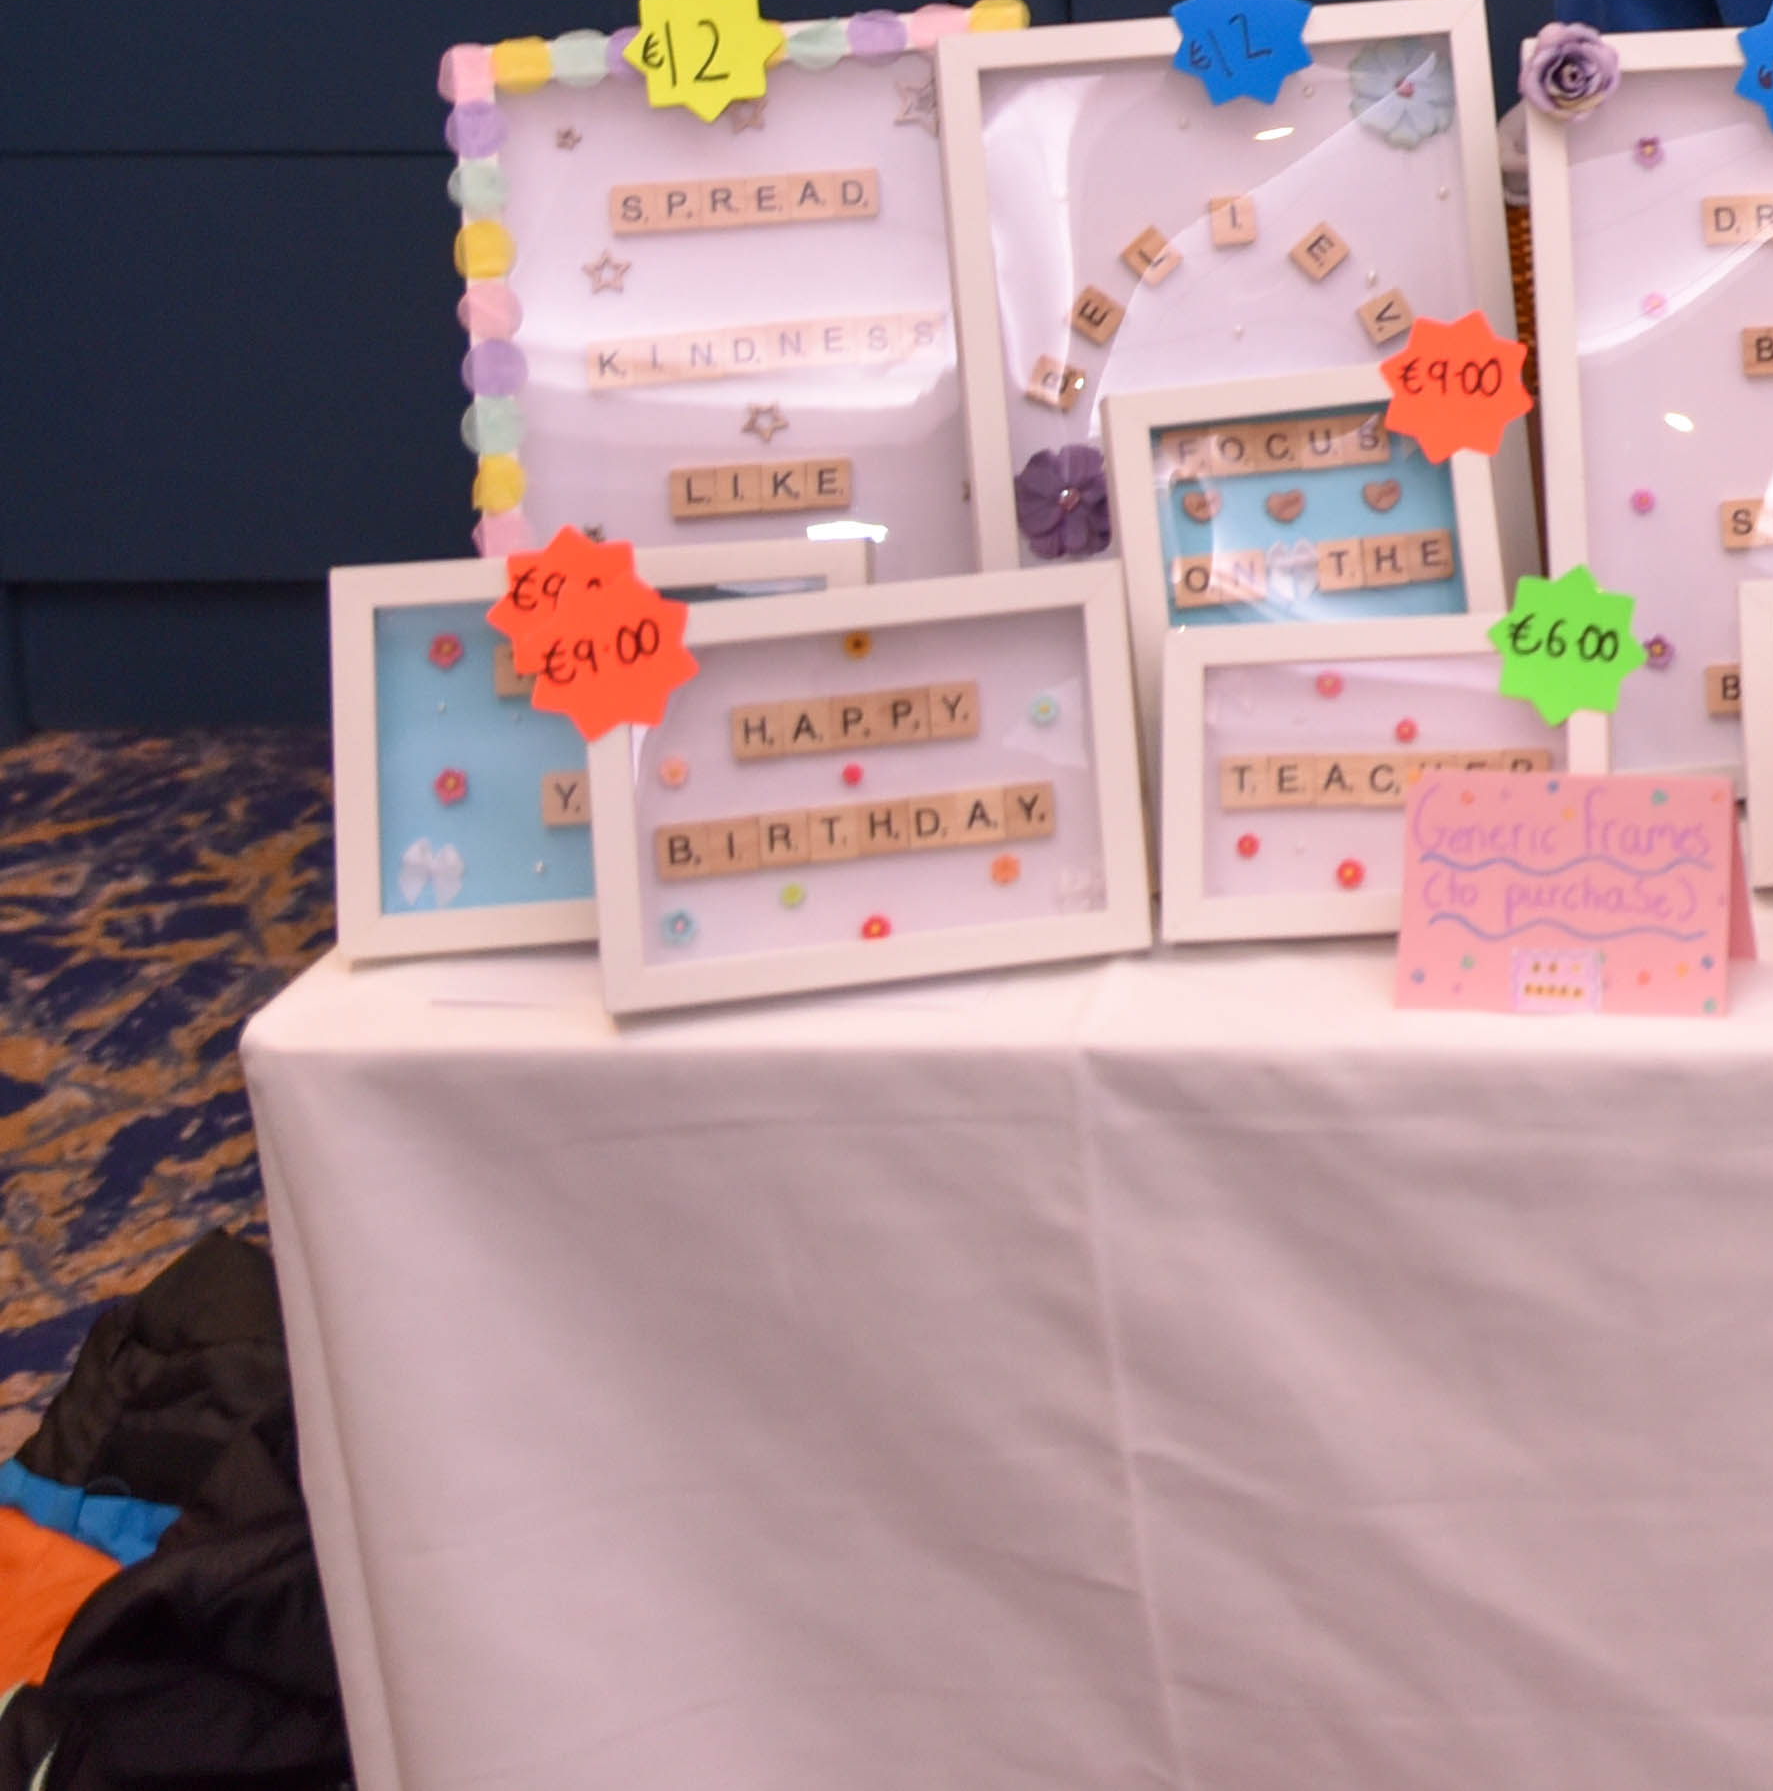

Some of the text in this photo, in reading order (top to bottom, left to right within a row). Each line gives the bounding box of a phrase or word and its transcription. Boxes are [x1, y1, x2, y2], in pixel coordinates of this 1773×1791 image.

[642, 19, 729, 87] €12
[1189, 12, 1272, 78] €12
[620, 177, 870, 223] SPREAD
[598, 317, 936, 378] KINDNESS
[1178, 423, 1384, 465] FOCUS
[685, 467, 845, 505] LIKE
[1172, 540, 1448, 595] ON THE
[543, 618, 661, 686] €9.00
[742, 694, 971, 747] HAPPY
[1231, 759, 1534, 797] TEAC
[669, 796, 1047, 867] BIRTHDAY
[1414, 783, 1558, 857] Generic
